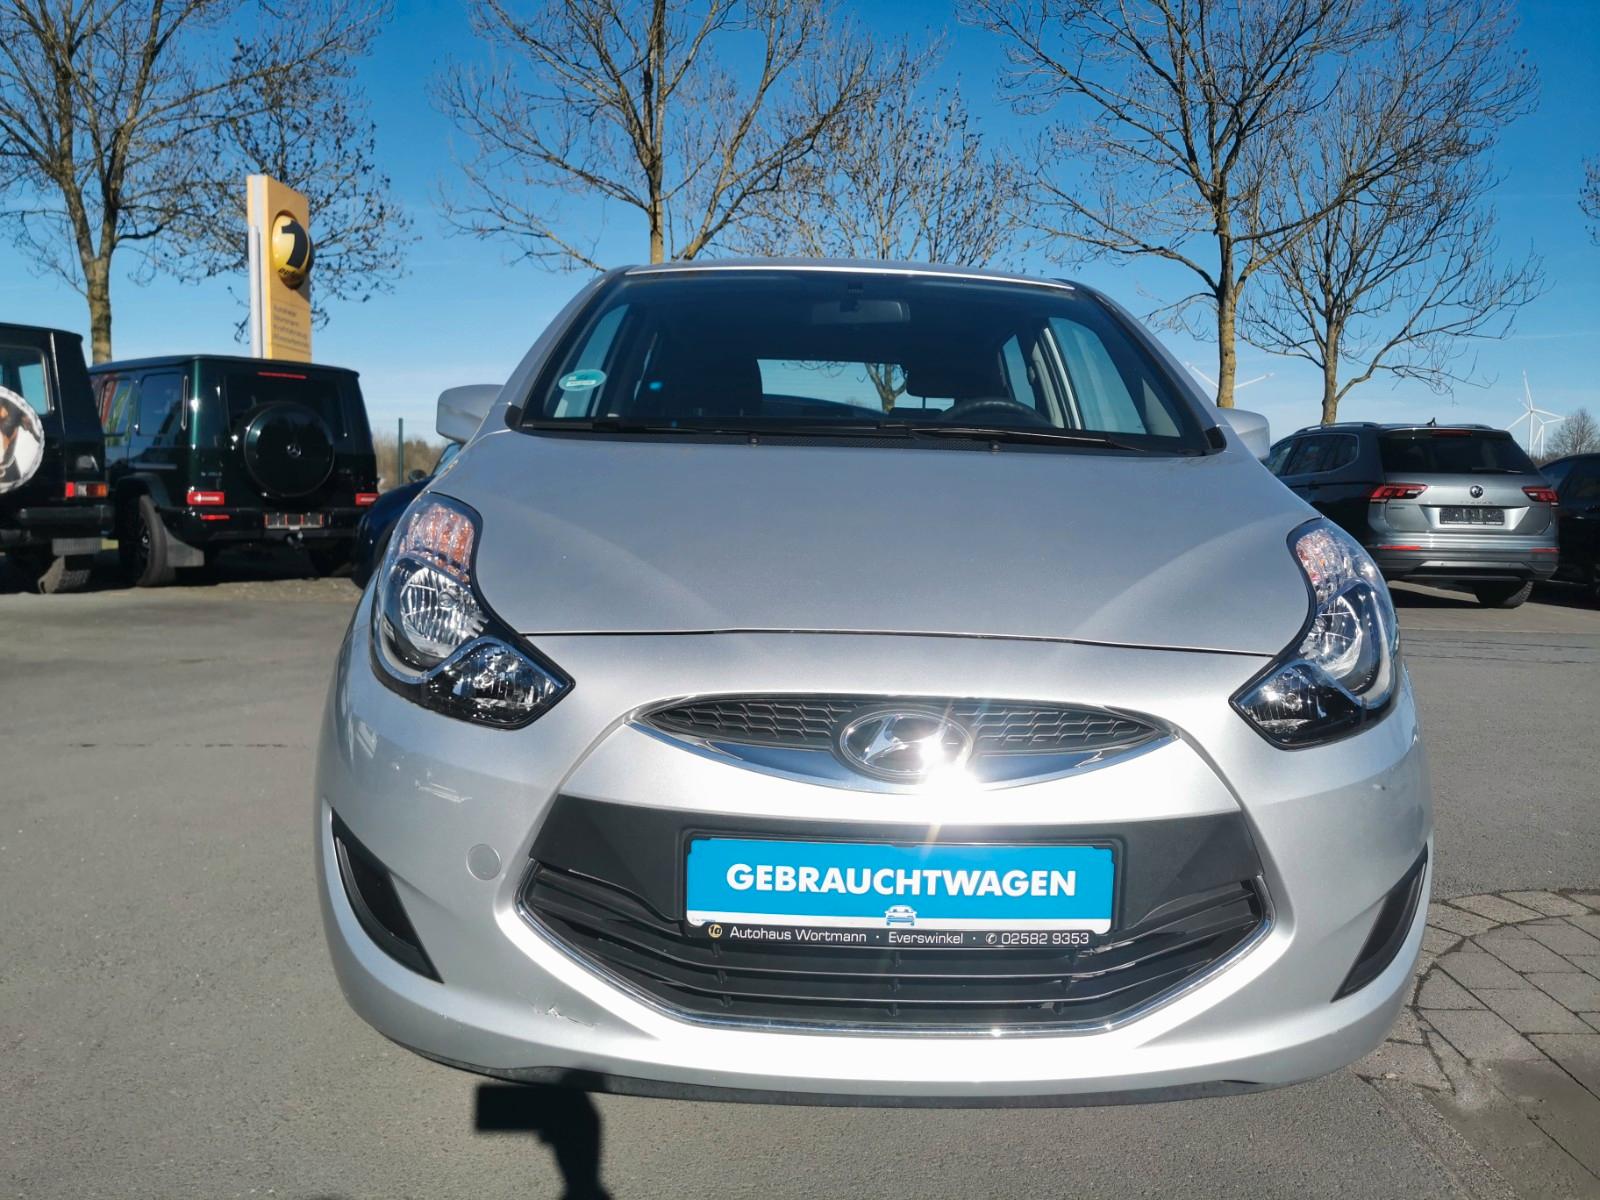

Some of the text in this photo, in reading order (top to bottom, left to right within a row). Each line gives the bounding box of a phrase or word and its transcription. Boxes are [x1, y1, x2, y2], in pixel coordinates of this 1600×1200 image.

[726, 863, 1076, 897] GEBRAUCHTWAGEN
[729, 926, 791, 941] Autohaus
[796, 929, 867, 943] Wortmann
[888, 931, 964, 945] Everswinkel
[1001, 933, 1048, 945] 02582
[1052, 932, 1089, 945] 9353
